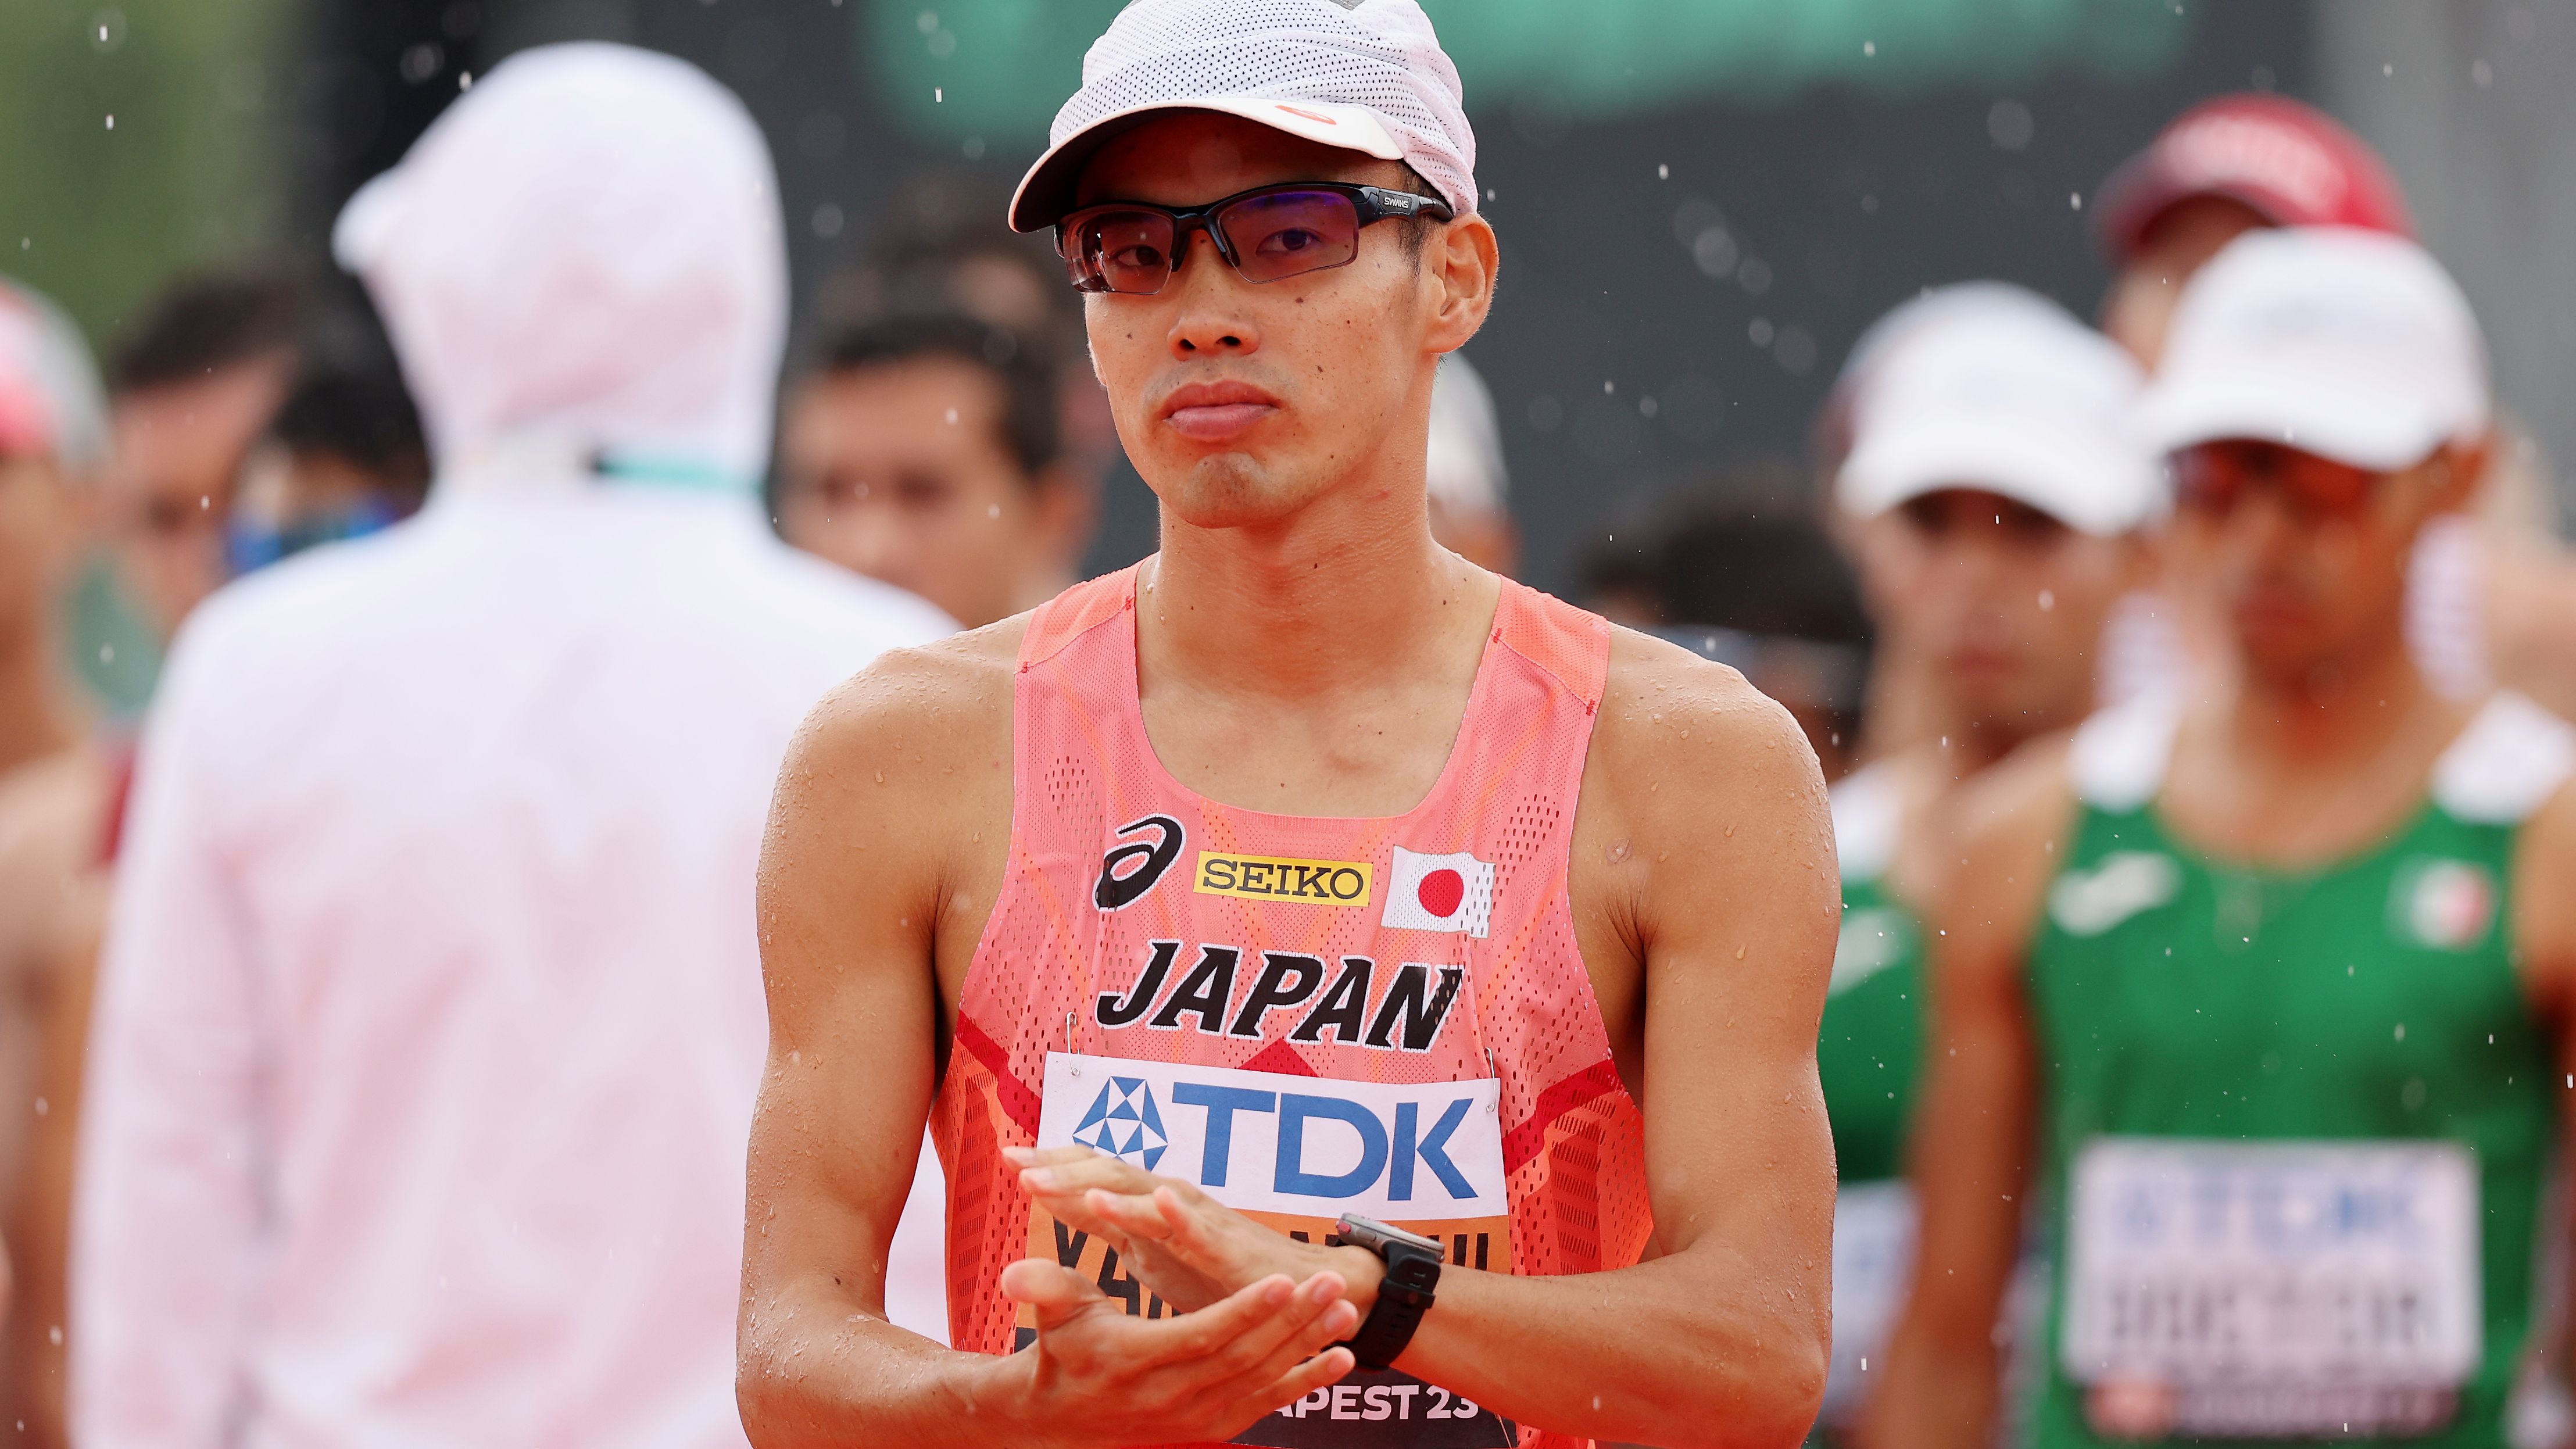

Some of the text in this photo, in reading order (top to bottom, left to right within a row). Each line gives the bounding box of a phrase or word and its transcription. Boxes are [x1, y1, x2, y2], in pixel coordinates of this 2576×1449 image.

[1384, 197, 1408, 209] SWANS
[1203, 858, 1364, 900] SEIKO
[1094, 938, 1465, 1054] JAPAN
[1172, 1082, 1479, 1201] TDK
